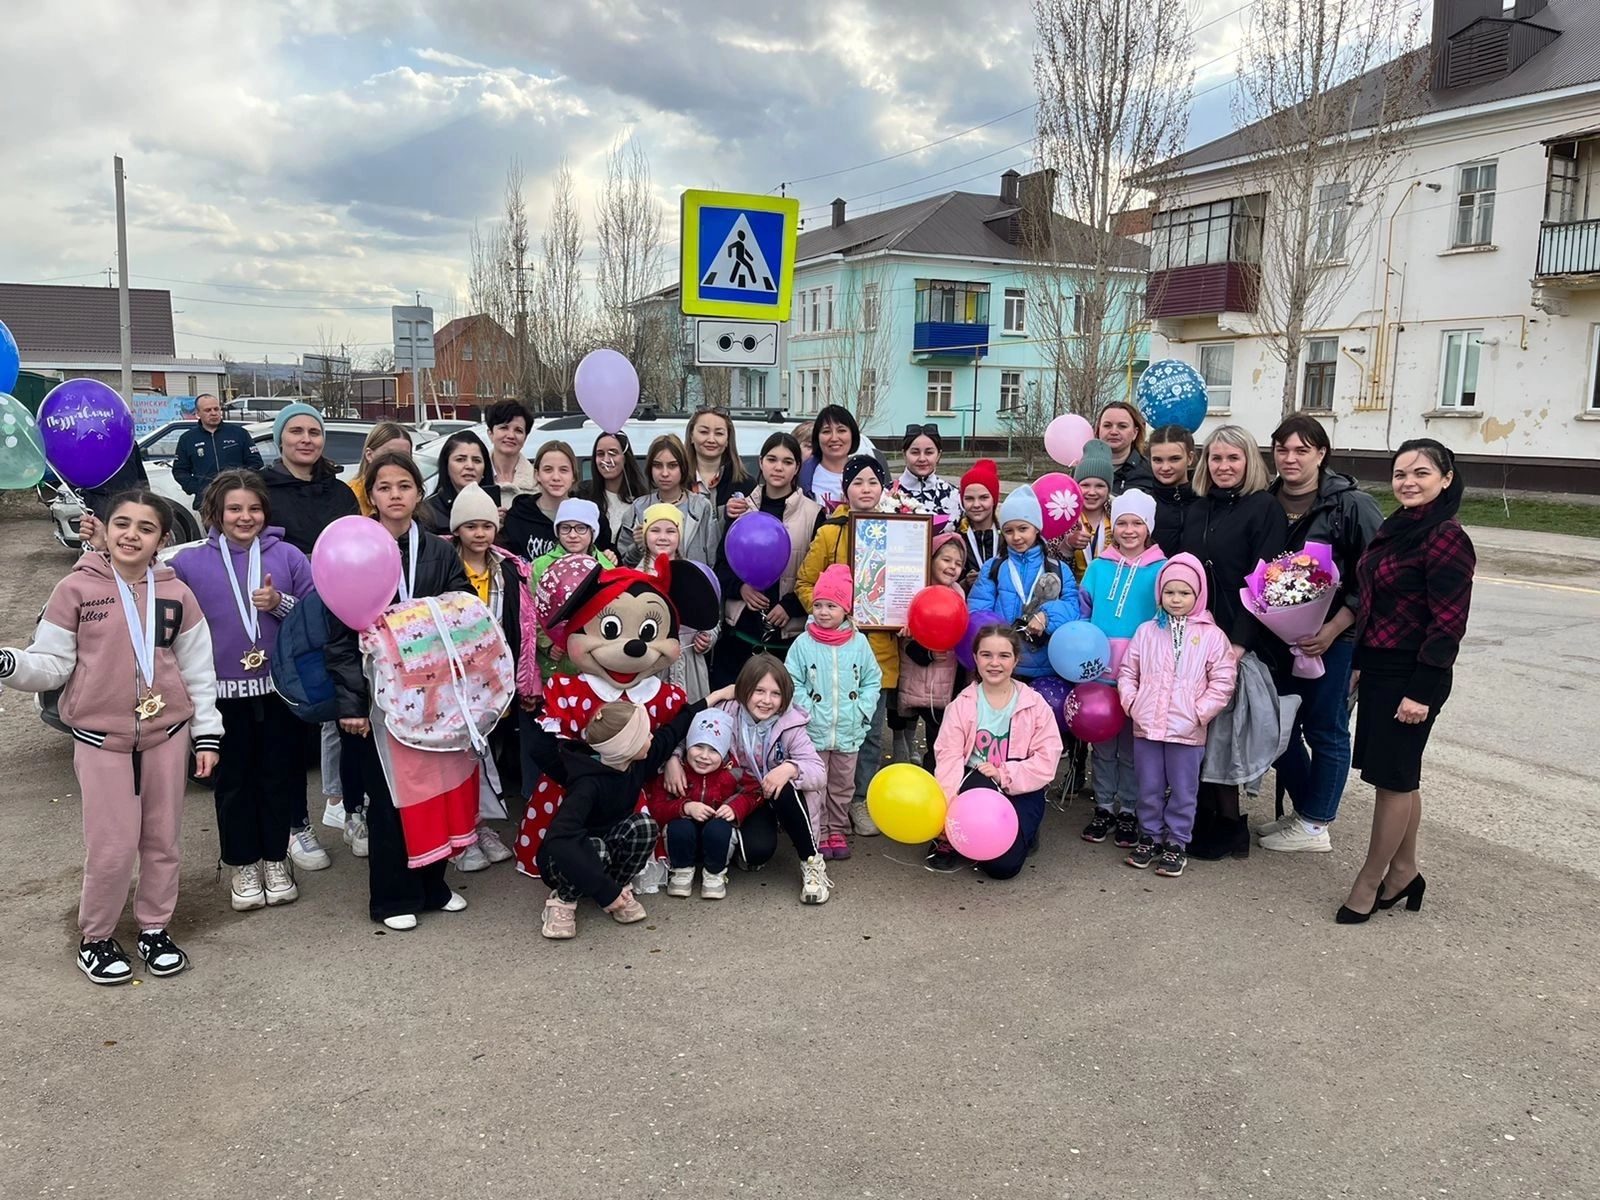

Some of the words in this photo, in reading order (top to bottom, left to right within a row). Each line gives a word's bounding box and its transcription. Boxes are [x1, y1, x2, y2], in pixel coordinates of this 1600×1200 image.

[80, 597, 116, 608] nnesota
[80, 610, 109, 623] ollege
[1080, 657, 1101, 669] ТАК
[216, 677, 275, 699] MPERIA
